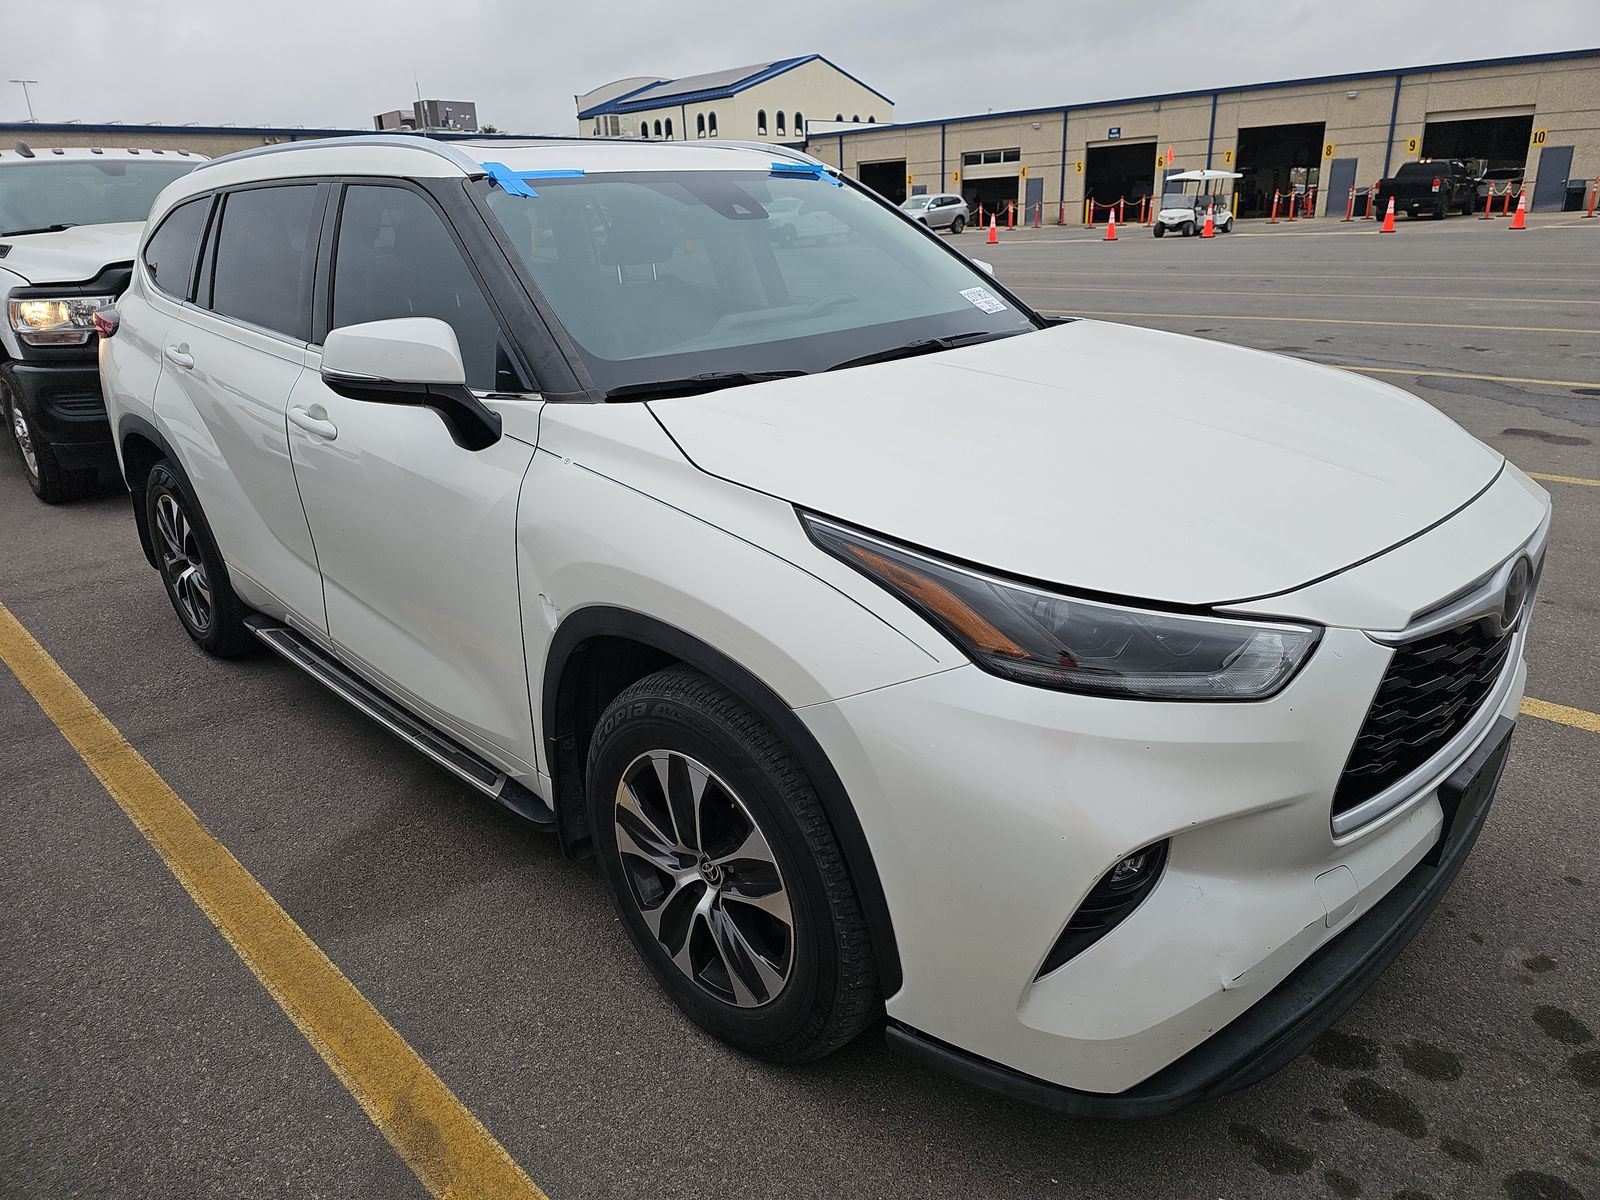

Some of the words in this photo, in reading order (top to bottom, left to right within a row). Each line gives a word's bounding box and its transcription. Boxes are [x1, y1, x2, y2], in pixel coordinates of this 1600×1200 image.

[1532, 131, 1545, 144] 10
[1325, 145, 1332, 156] 8
[1408, 139, 1415, 151] 9
[1158, 156, 1163, 167] 6
[1225, 151, 1231, 163] 7
[1077, 162, 1082, 172] 5
